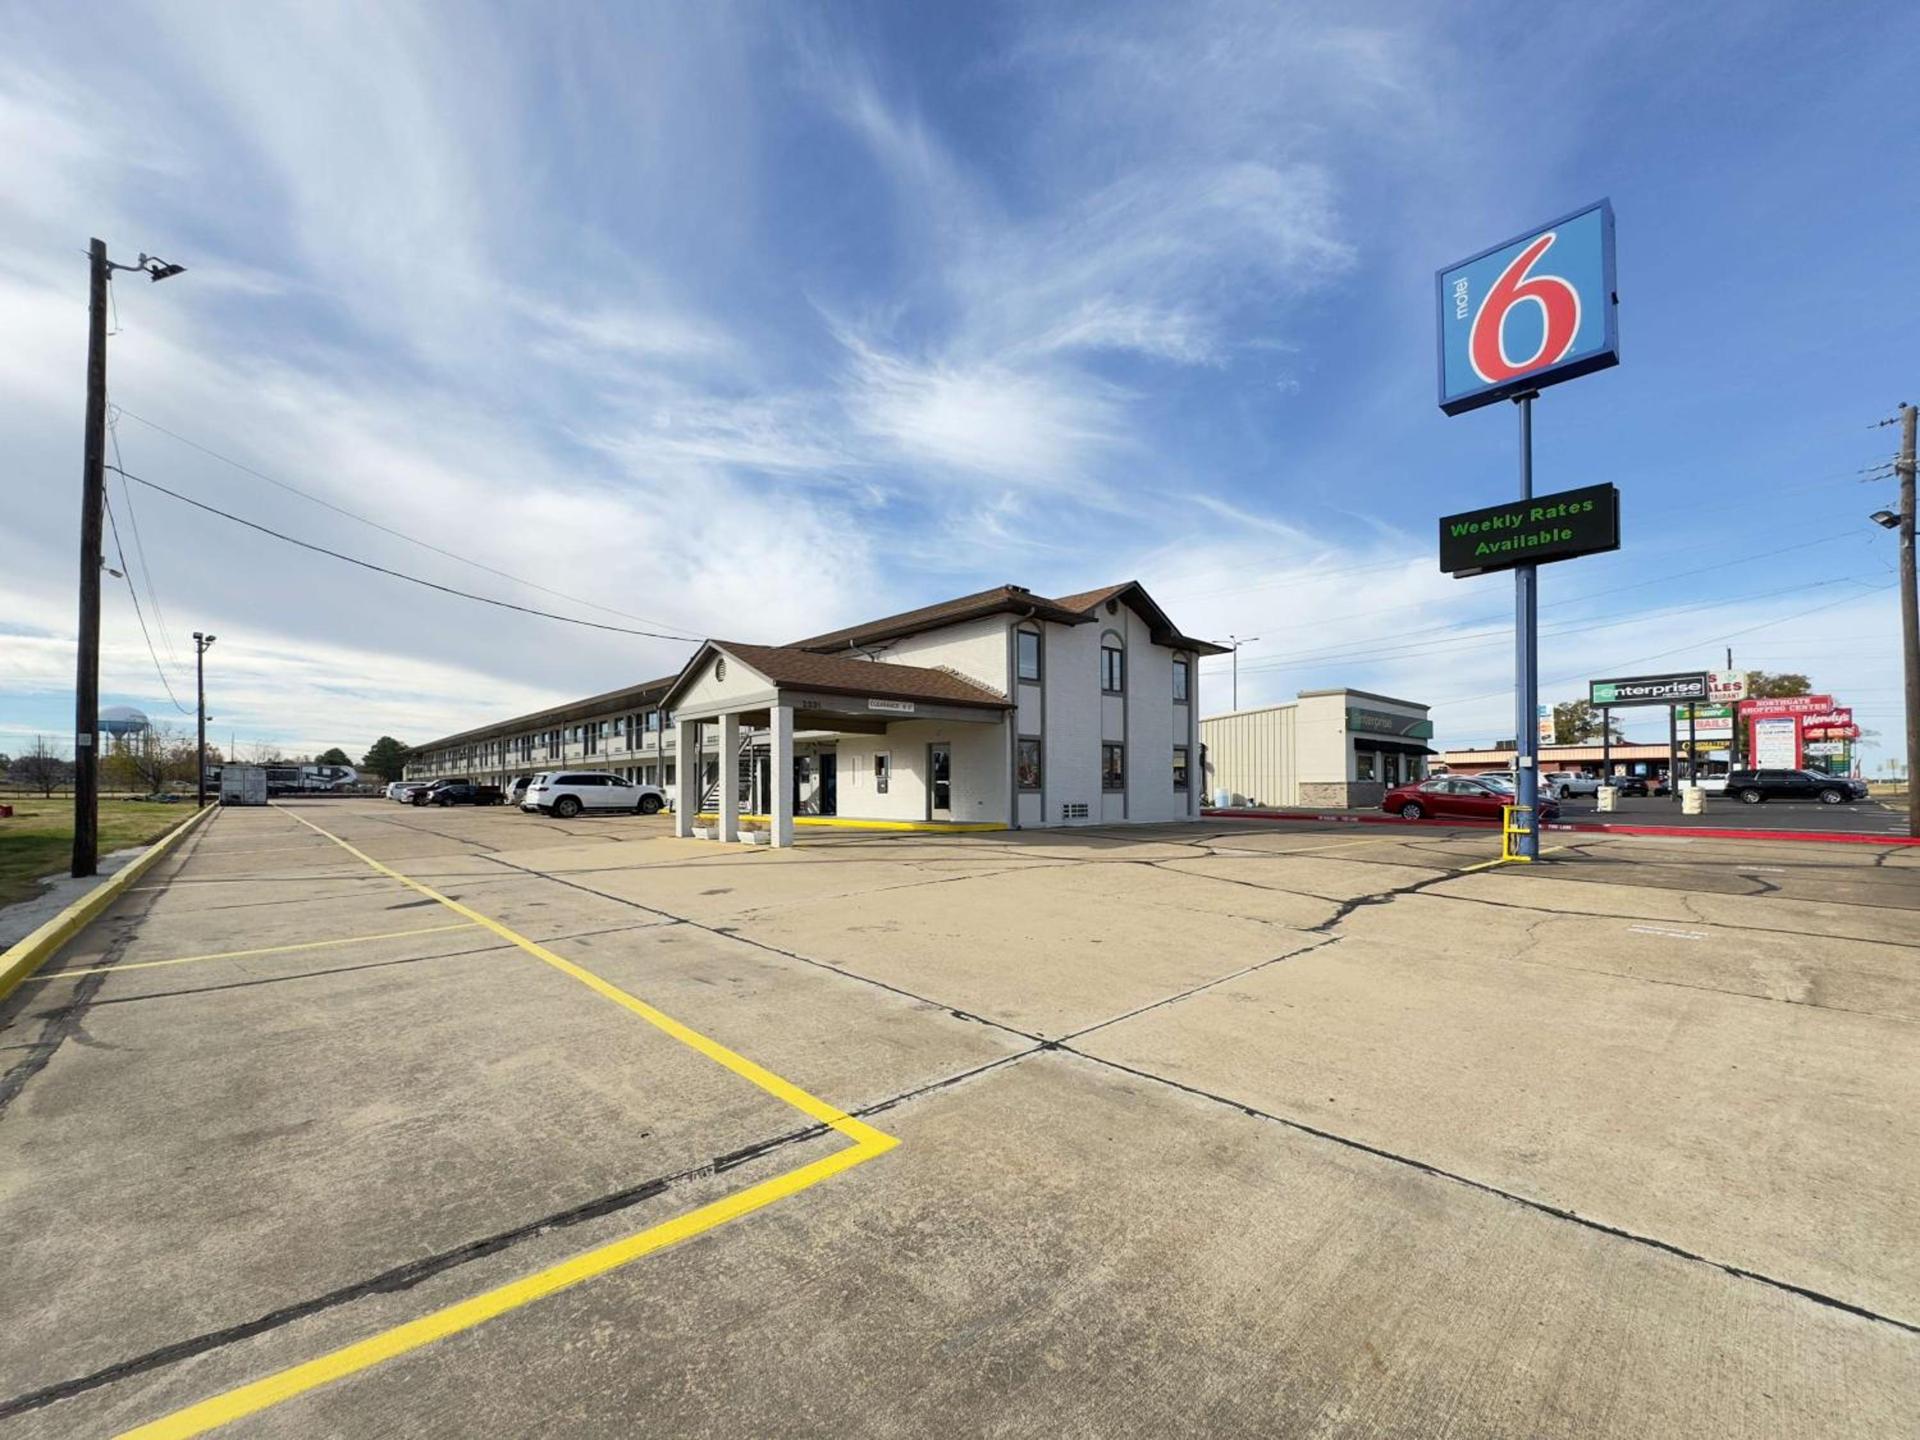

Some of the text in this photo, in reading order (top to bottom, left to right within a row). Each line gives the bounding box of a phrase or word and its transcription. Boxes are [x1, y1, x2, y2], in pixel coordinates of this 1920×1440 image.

[1456, 277, 1469, 320] motel
[1468, 231, 1582, 385] 6
[1450, 500, 1594, 537] Weekly Rates
[1474, 527, 1573, 556] Available
[1599, 681, 1702, 698] enterprise
[1789, 703, 1828, 712] CENTER
[1802, 711, 1850, 726] Wendy's
